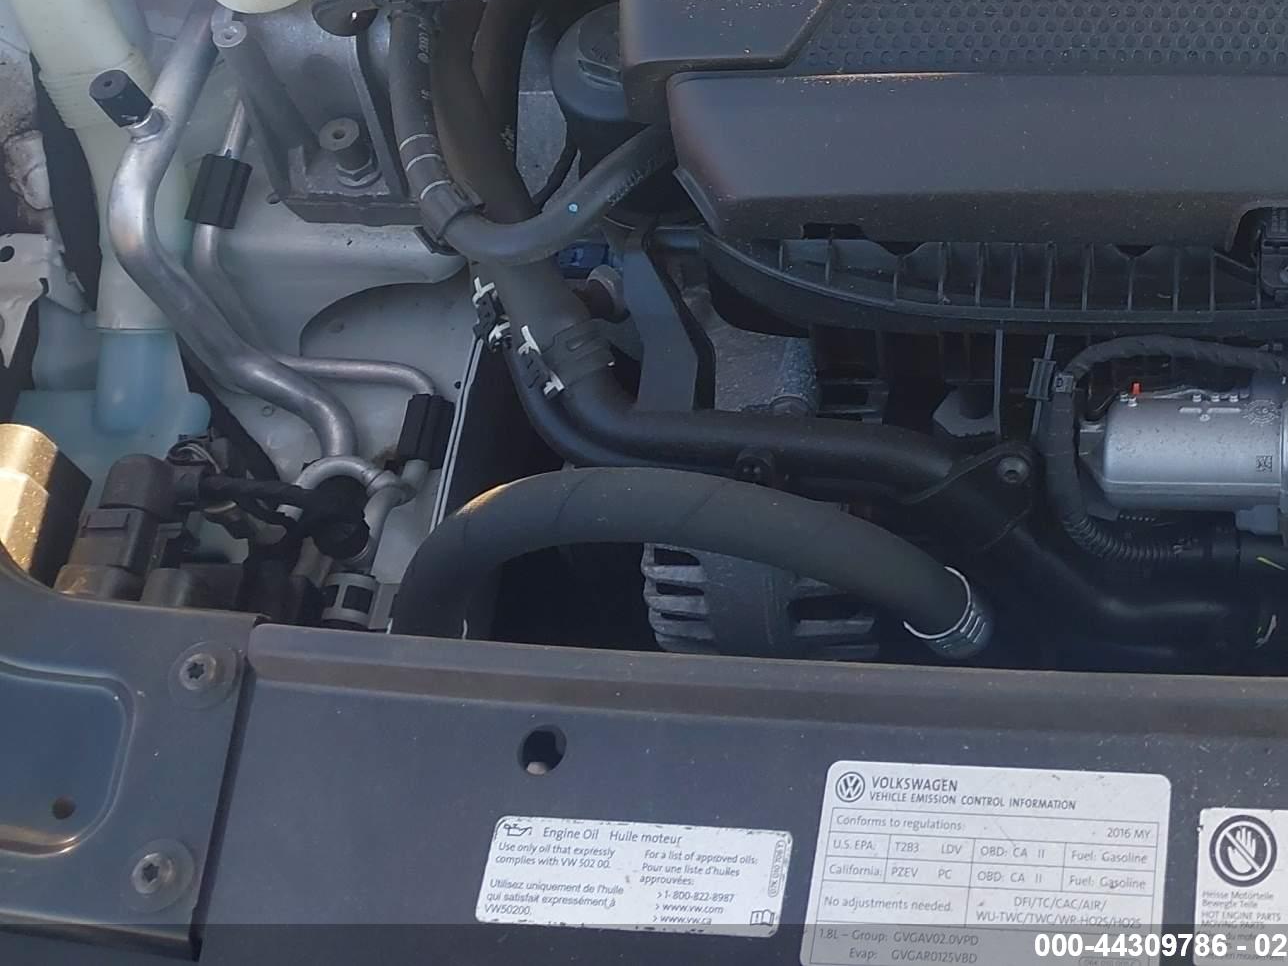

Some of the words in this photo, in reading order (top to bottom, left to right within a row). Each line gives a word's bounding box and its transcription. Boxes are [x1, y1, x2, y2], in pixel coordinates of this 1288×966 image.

[871, 776, 958, 792] VOLKSWAGEN
[869, 794, 907, 803] VEHICLE
[911, 795, 956, 805] EMISSION
[961, 795, 1005, 807] CONTROL
[1009, 798, 1076, 810] INFORMATION
[836, 814, 888, 828] Conforms
[890, 817, 900, 828] to
[543, 826, 580, 843] Engine
[583, 829, 598, 841] Oil
[609, 830, 638, 843] Huile
[641, 832, 682, 845] moteur
[1107, 827, 1131, 838] 2016
[1134, 828, 1150, 839] MY
[499, 843, 515, 852] Use
[517, 845, 536, 855] only
[537, 844, 550, 853] oil
[552, 845, 571, 855] that
[573, 847, 616, 858] expressly
[645, 850, 659, 859] For
[661, 852, 666, 860] a
[668, 852, 682, 860] list
[684, 852, 694, 861] of
[696, 853, 737, 865] approved
[833, 838, 852, 851] U.S.
[895, 841, 920, 853] T2B3
[941, 844, 962, 855] LDV
[980, 846, 1008, 858] OBD:
[1012, 848, 1028, 859] CA
[1071, 850, 1097, 862] Fuel:
[1101, 852, 1147, 865] Gasoline
[495, 854, 535, 867] complies
[538, 856, 558, 866] with
[561, 858, 577, 867] VW
[579, 858, 595, 868] 502
[596, 859, 610, 868] 00.
[642, 863, 664, 873] Pour
[666, 866, 682, 874] une
[685, 866, 704, 875] liste
[706, 866, 740, 877] d'huiles
[891, 866, 919, 878] PZEV
[938, 869, 952, 880] PC
[977, 870, 1005, 882] OBD:
[1010, 872, 1025, 882] CA
[1069, 875, 1095, 887] Fuel:
[1100, 876, 1146, 890] Gasoline
[490, 879, 524, 889] Utilisez
[526, 881, 580, 894] uniquement
[583, 883, 595, 893] de
[598, 884, 624, 895] l'huile
[486, 893, 501, 903] qui
[503, 893, 539, 903] satisfait
[542, 895, 607, 909] expressément
[609, 897, 615, 907] à
[663, 903, 724, 914] www.vw.com
[823, 896, 839, 907] No
[841, 897, 909, 912] adjustments
[912, 901, 953, 913] needed.
[660, 915, 711, 924] www.vw.ca
[819, 928, 839, 939] 1.8L
[852, 930, 888, 944] Group:
[849, 948, 878, 960] Evap:
